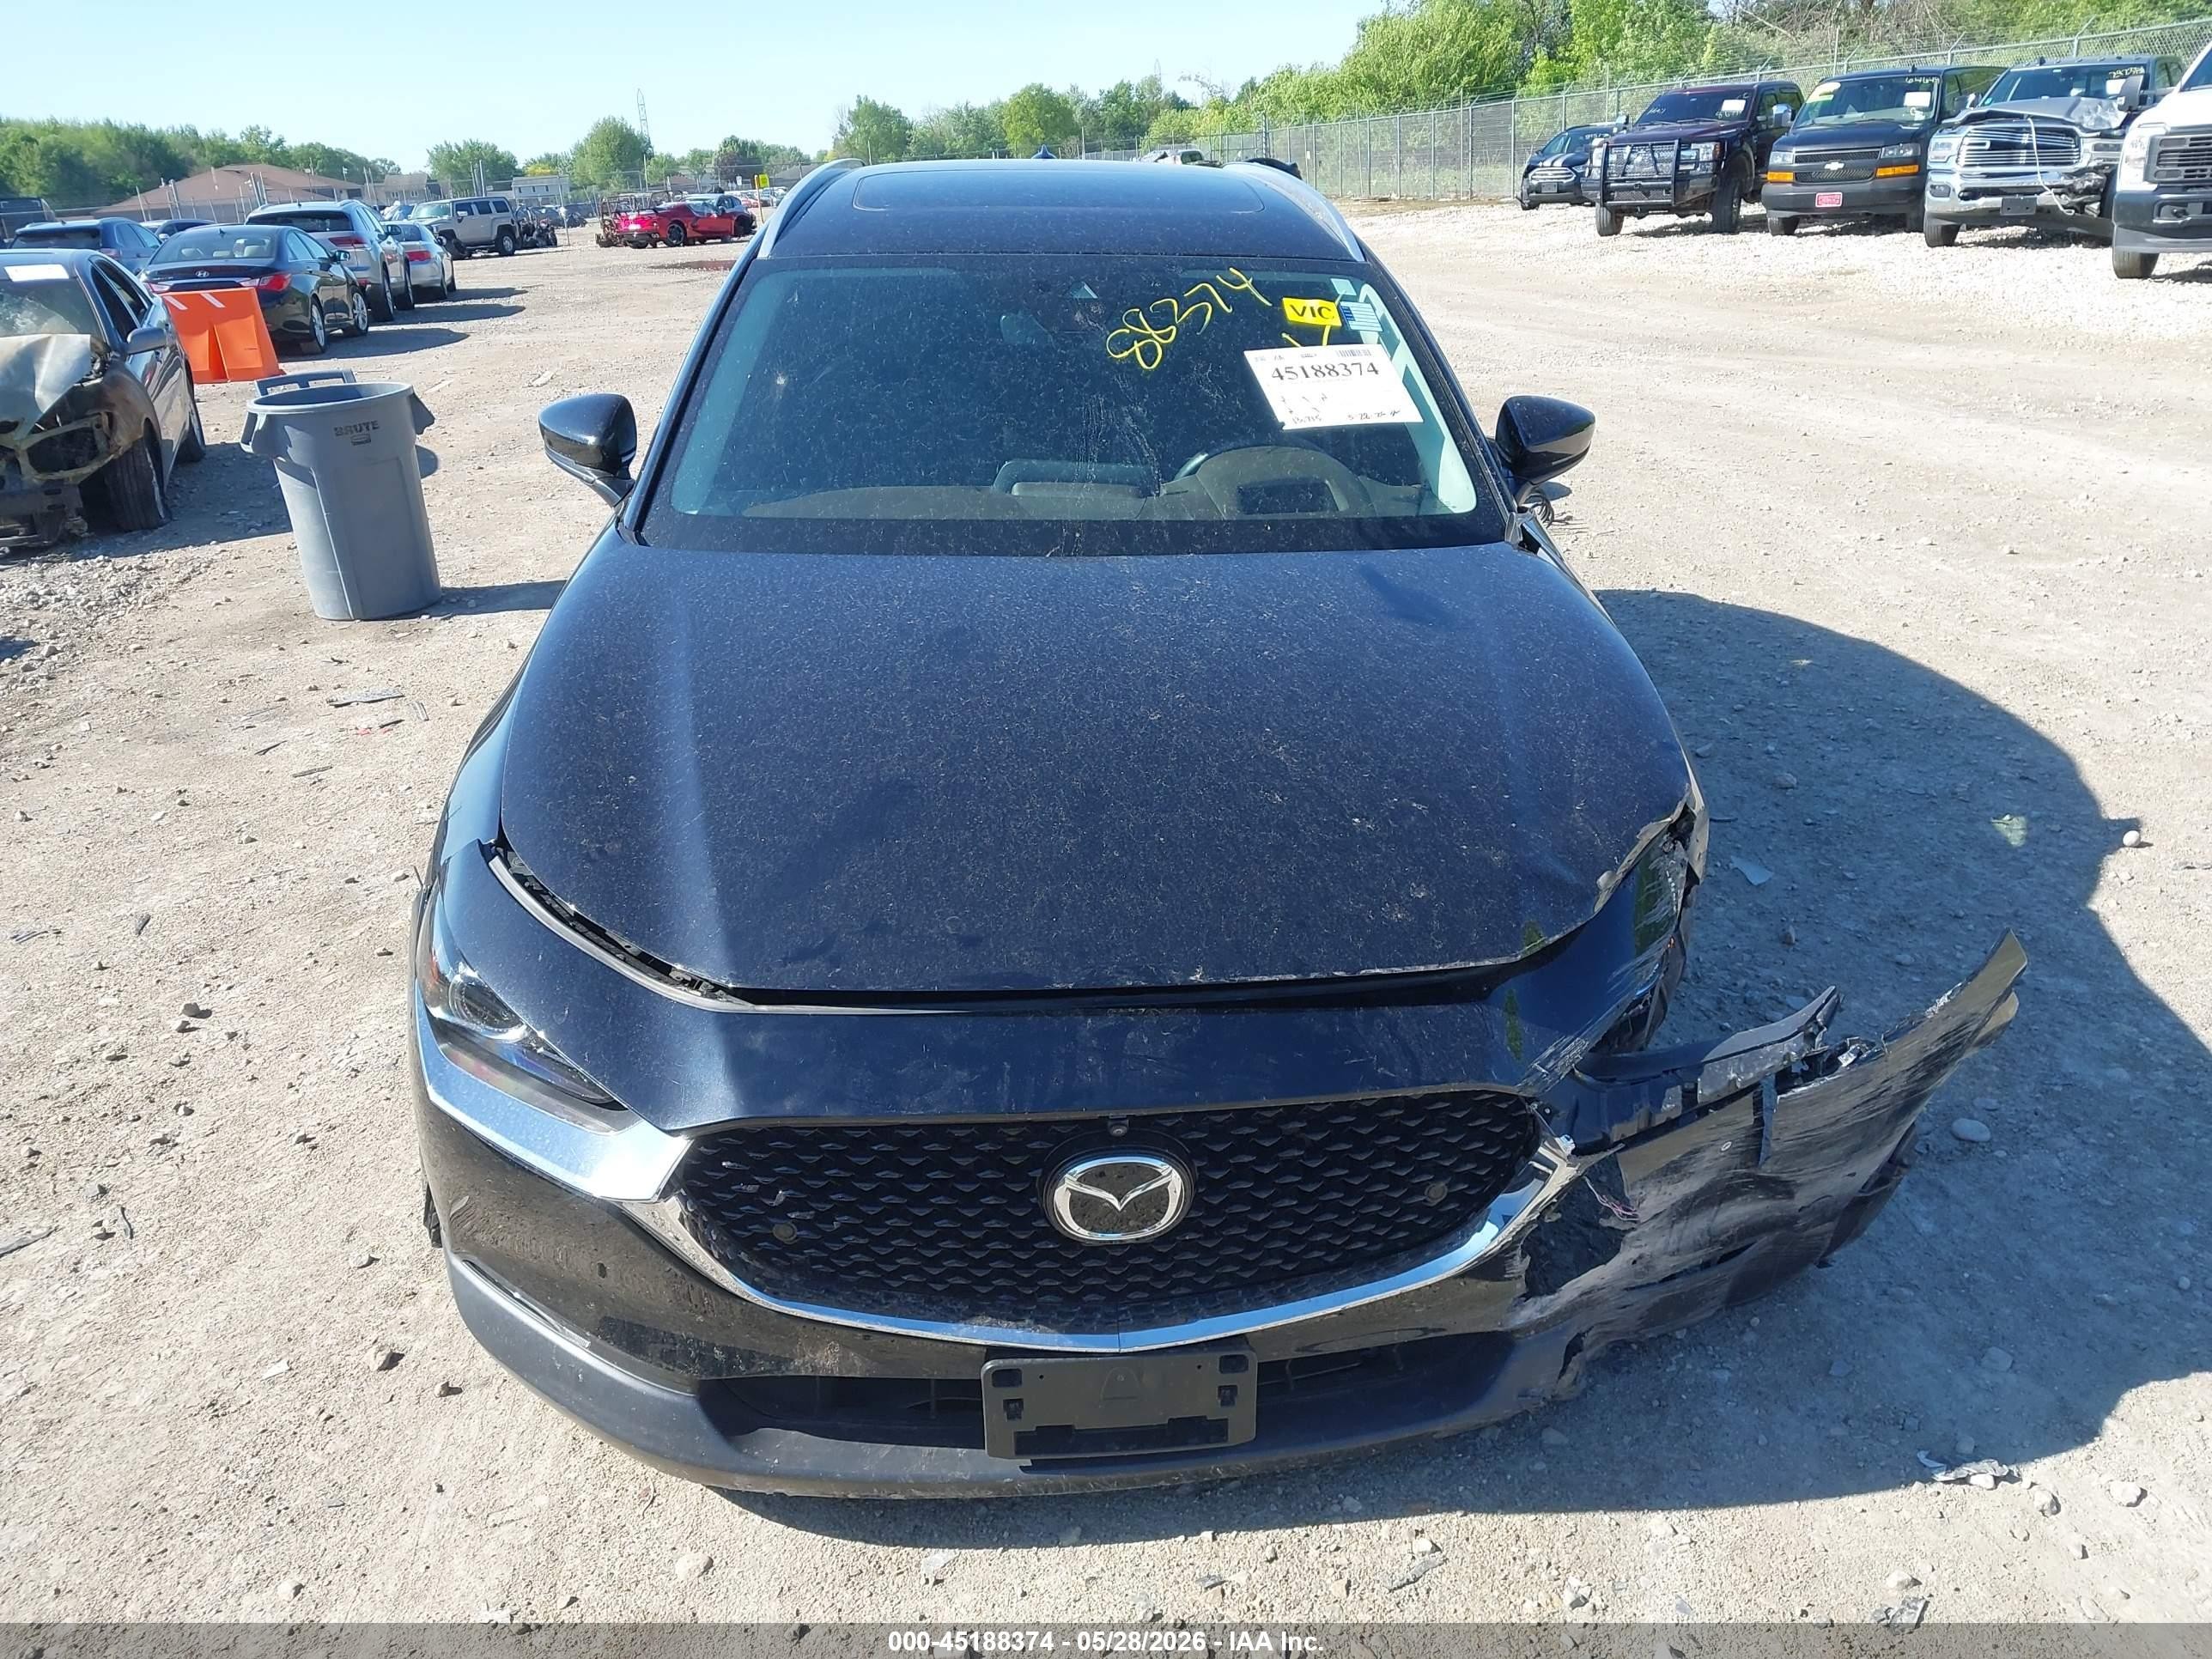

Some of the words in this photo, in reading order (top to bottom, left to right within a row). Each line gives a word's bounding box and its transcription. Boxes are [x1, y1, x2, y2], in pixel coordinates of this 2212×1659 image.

[1106, 267, 1273, 369] 88374
[1290, 303, 1334, 319] VIC
[1272, 362, 1379, 380] 45188374
[333, 420, 380, 437] BRUTE
